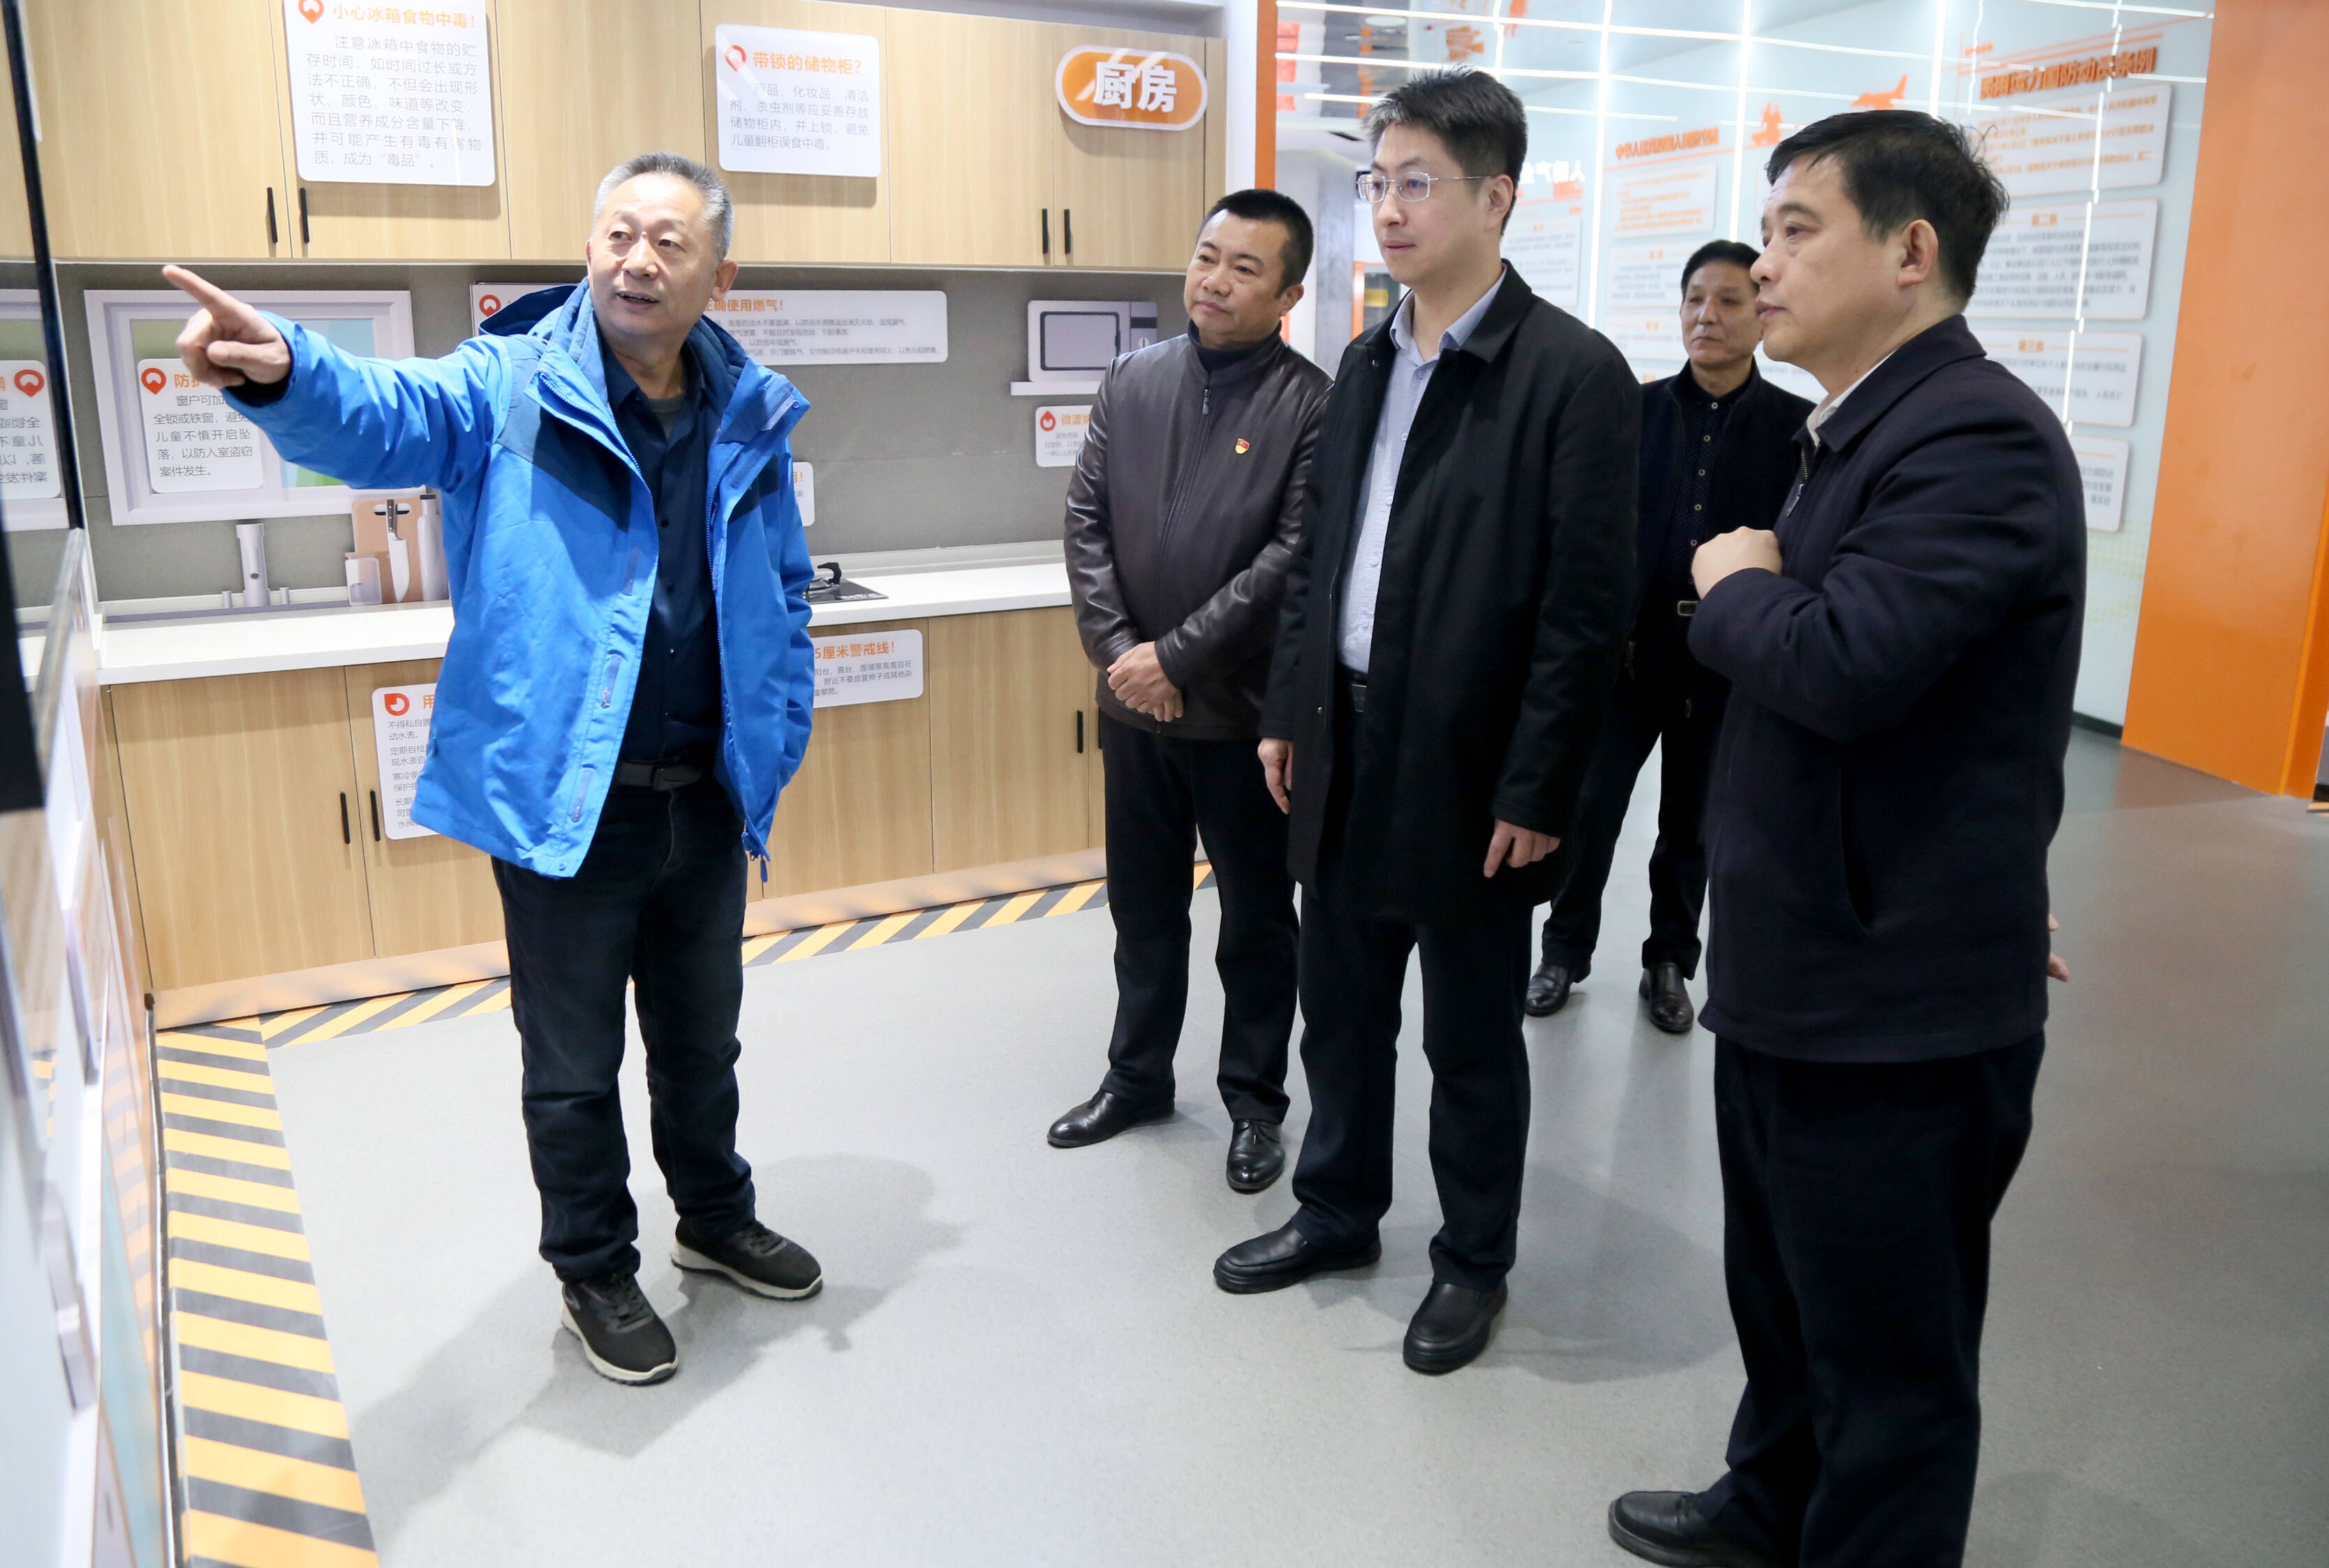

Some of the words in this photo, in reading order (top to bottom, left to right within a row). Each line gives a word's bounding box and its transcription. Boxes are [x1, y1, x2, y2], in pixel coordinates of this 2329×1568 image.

[333, 5, 475, 28] 小心冰箱食物中毒！
[335, 35, 478, 57] 注意冰箱中食物的贮
[1093, 61, 1177, 112] 厨房
[156, 429, 252, 443] 儿童不慎开启坠
[157, 447, 253, 460] 落，以防入室盗窃
[159, 464, 212, 478] 案件发生。
